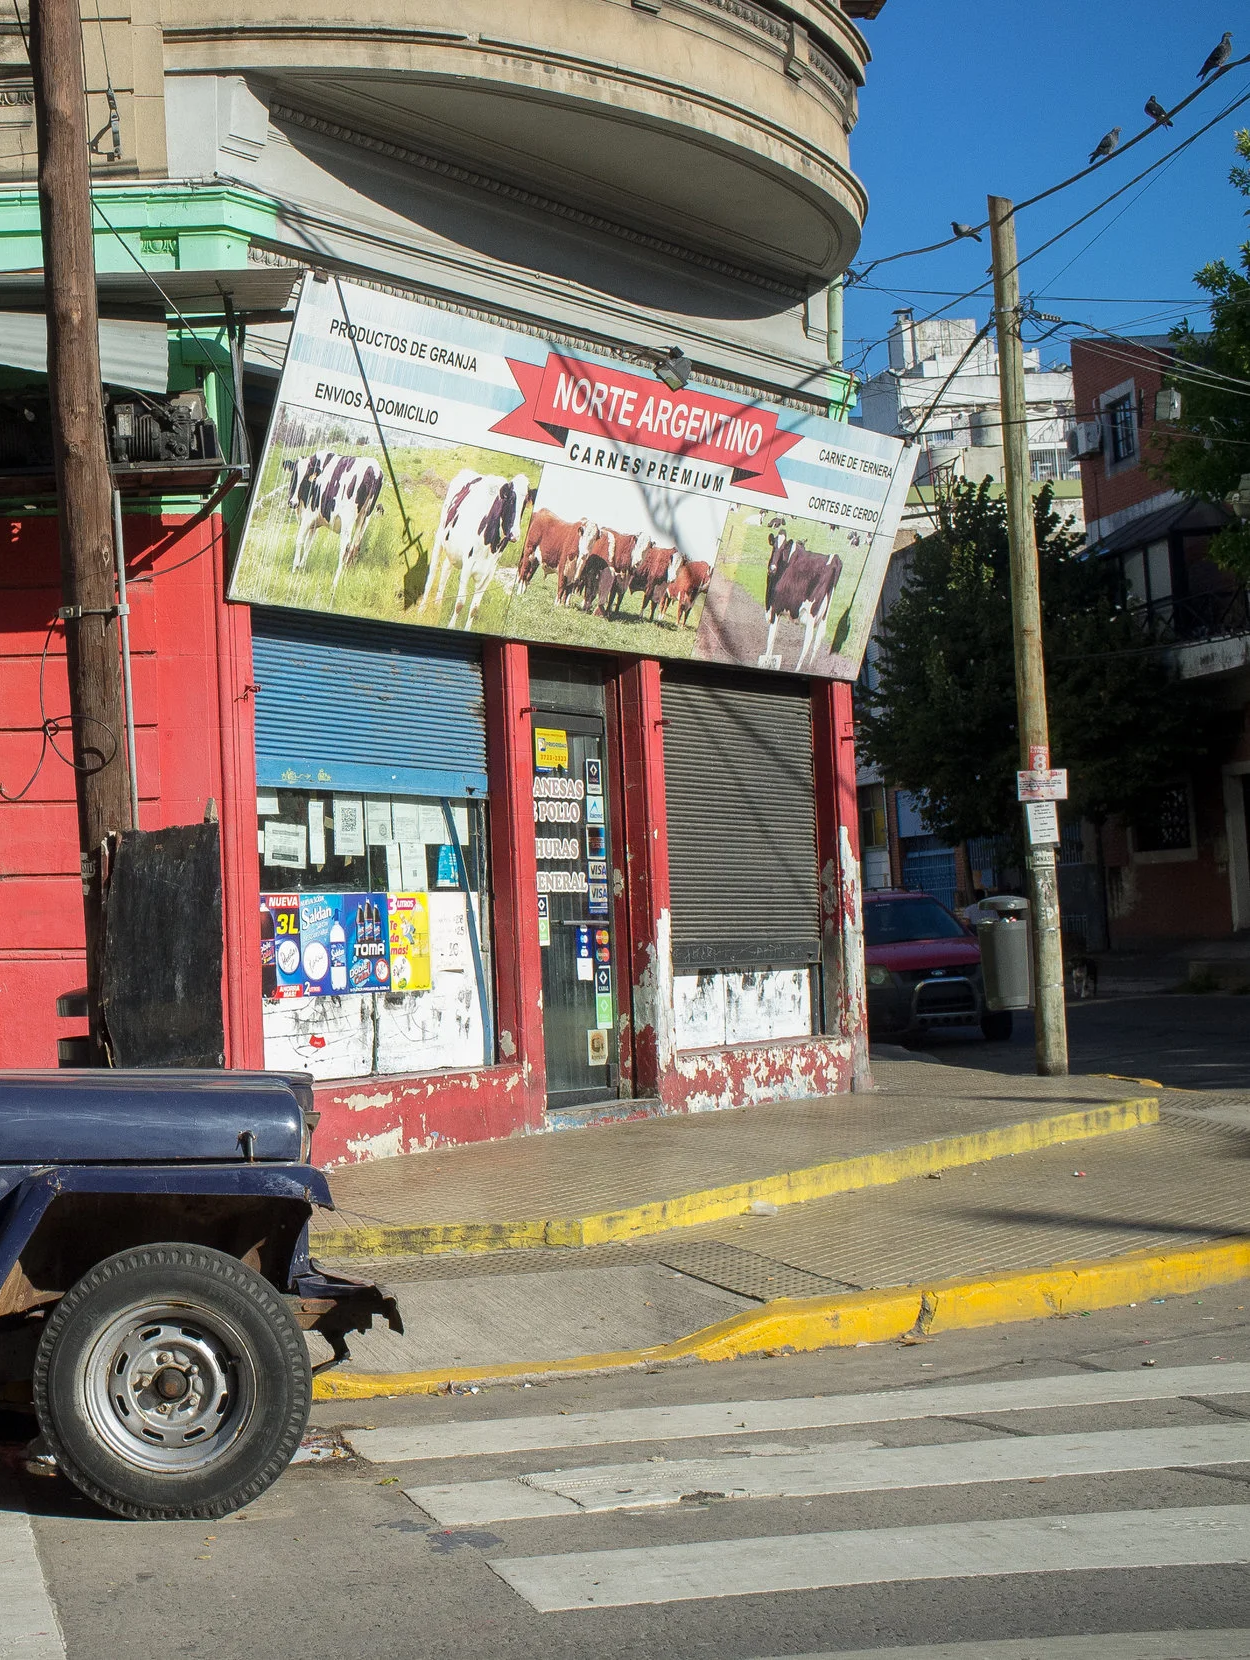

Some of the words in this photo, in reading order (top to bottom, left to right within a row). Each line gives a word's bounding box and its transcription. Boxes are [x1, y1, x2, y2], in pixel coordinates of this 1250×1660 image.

[329, 319, 408, 354] PRODUCTOS
[410, 341, 428, 359] DE
[429, 346, 478, 373] GRANJA
[314, 382, 363, 409] ENVIOS
[364, 395, 375, 412] A
[375, 397, 439, 426] DOMICILIO
[552, 372, 639, 427] NORTE
[636, 396, 763, 457] ARGENTINO
[569, 443, 643, 475] CARNES
[646, 461, 726, 493] PREMIUM
[818, 448, 847, 468] CARNE
[846, 456, 859, 470] DE
[859, 459, 893, 479] TERNERA
[808, 496, 841, 515] CORTES
[840, 503, 853, 518] DE
[852, 506, 880, 523] CERDO
[533, 776, 585, 801] ANESAS
[538, 800, 581, 823] POLLO
[535, 837, 580, 860] HURAS
[590, 863, 607, 875] VISA
[536, 871, 589, 893] ENERAL
[591, 886, 608, 898] VISA
[268, 896, 299, 907] NUEVA
[388, 895, 398, 915] 3
[276, 913, 300, 935] 3L
[389, 920, 398, 931] Te
[389, 934, 400, 943] da
[390, 944, 409, 955] más!
[304, 981, 311, 997] 2
